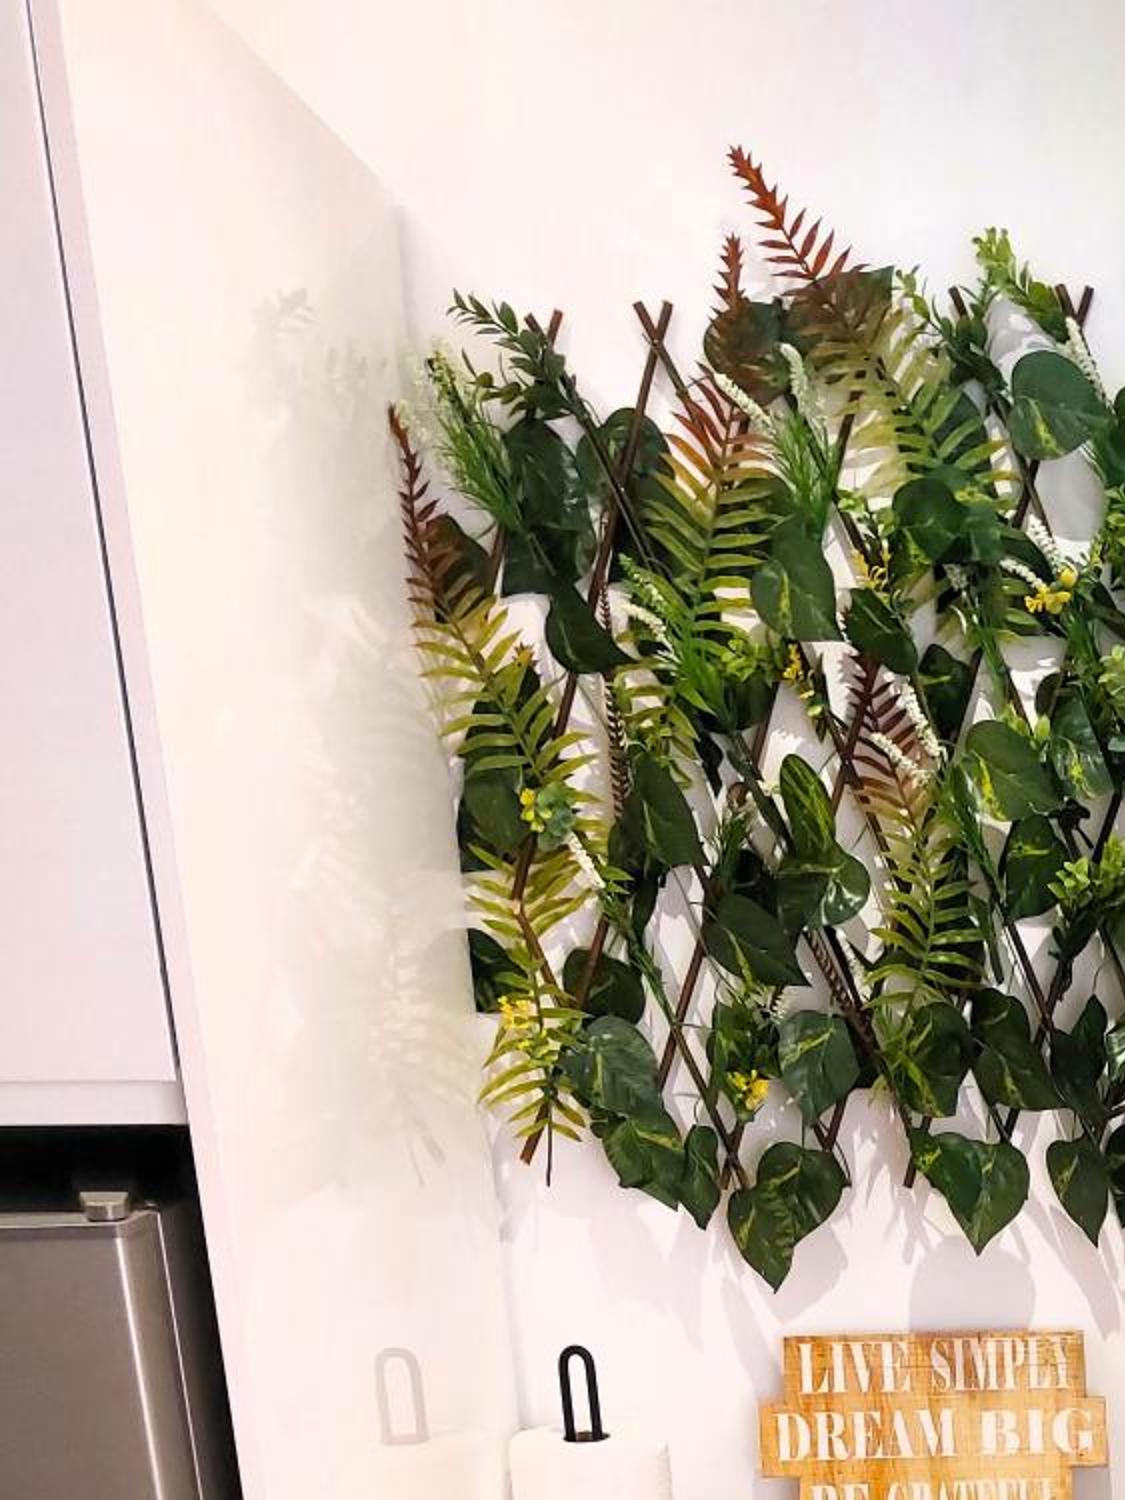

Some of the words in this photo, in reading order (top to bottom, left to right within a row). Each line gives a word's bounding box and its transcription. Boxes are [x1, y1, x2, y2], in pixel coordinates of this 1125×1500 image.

[799, 1342, 912, 1394] LIVE
[931, 1337, 1070, 1391] SIMPLY
[774, 1408, 957, 1461] DREAM
[979, 1406, 1094, 1455] BIG
